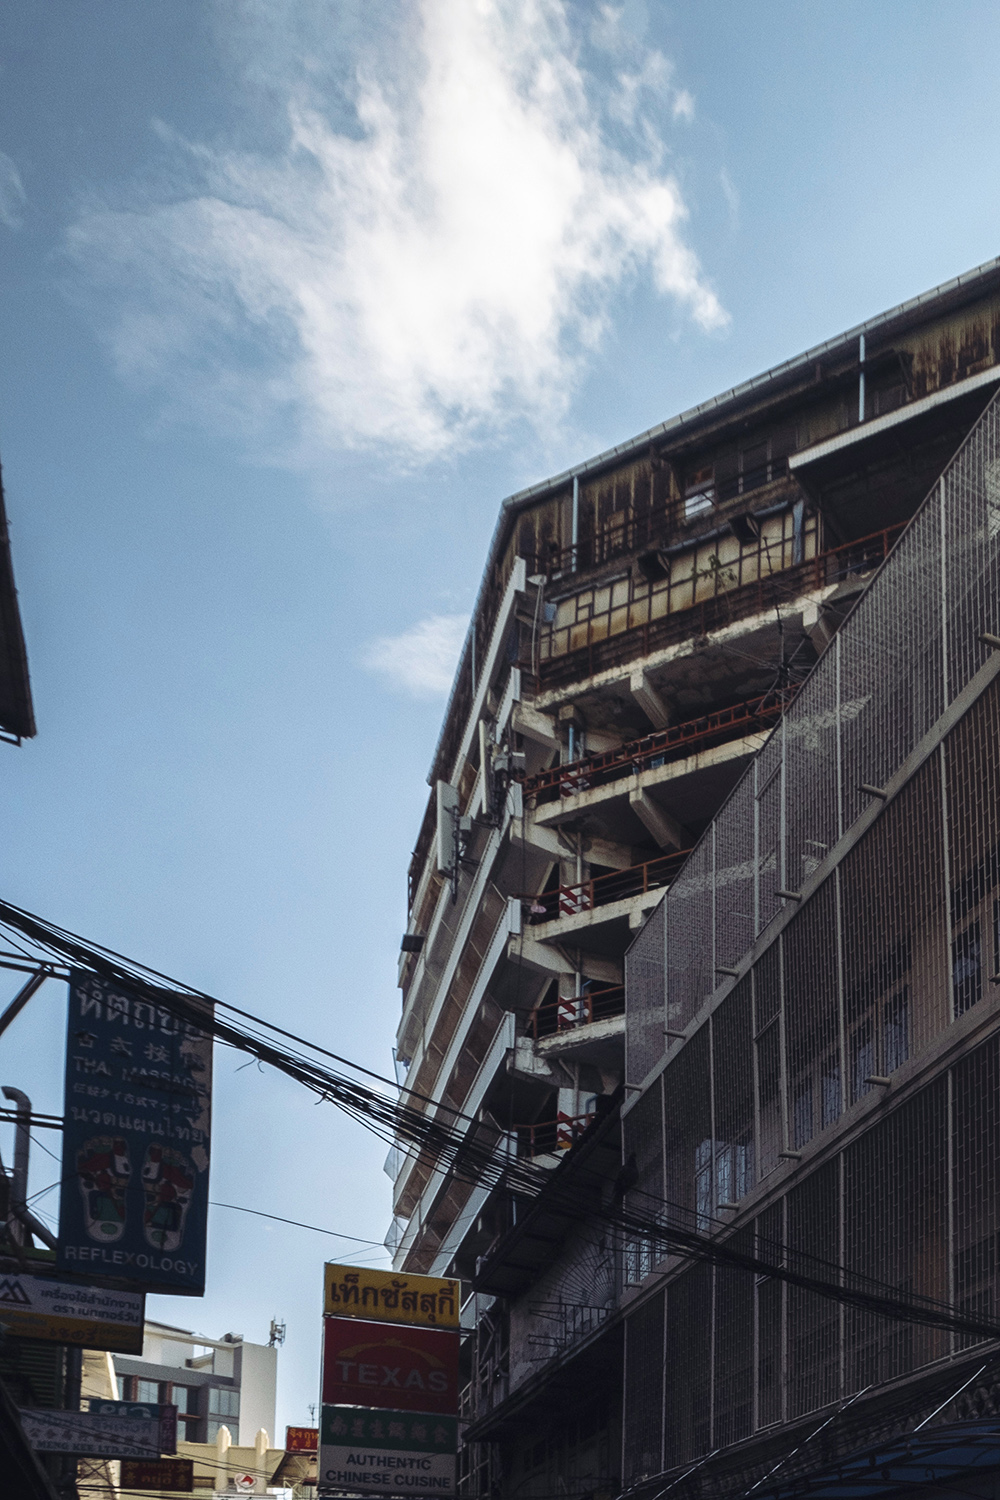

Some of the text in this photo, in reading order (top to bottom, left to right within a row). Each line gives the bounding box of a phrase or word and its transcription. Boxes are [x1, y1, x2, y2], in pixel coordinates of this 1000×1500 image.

[64, 1245, 198, 1276] REFLEXOLOGY
[331, 1273, 457, 1322] เท็กซัสสุกี้
[335, 1361, 449, 1392] TEXAS
[346, 1453, 432, 1471] AUTHENTIC
[325, 1469, 450, 1489] CHINESE CUISINE
